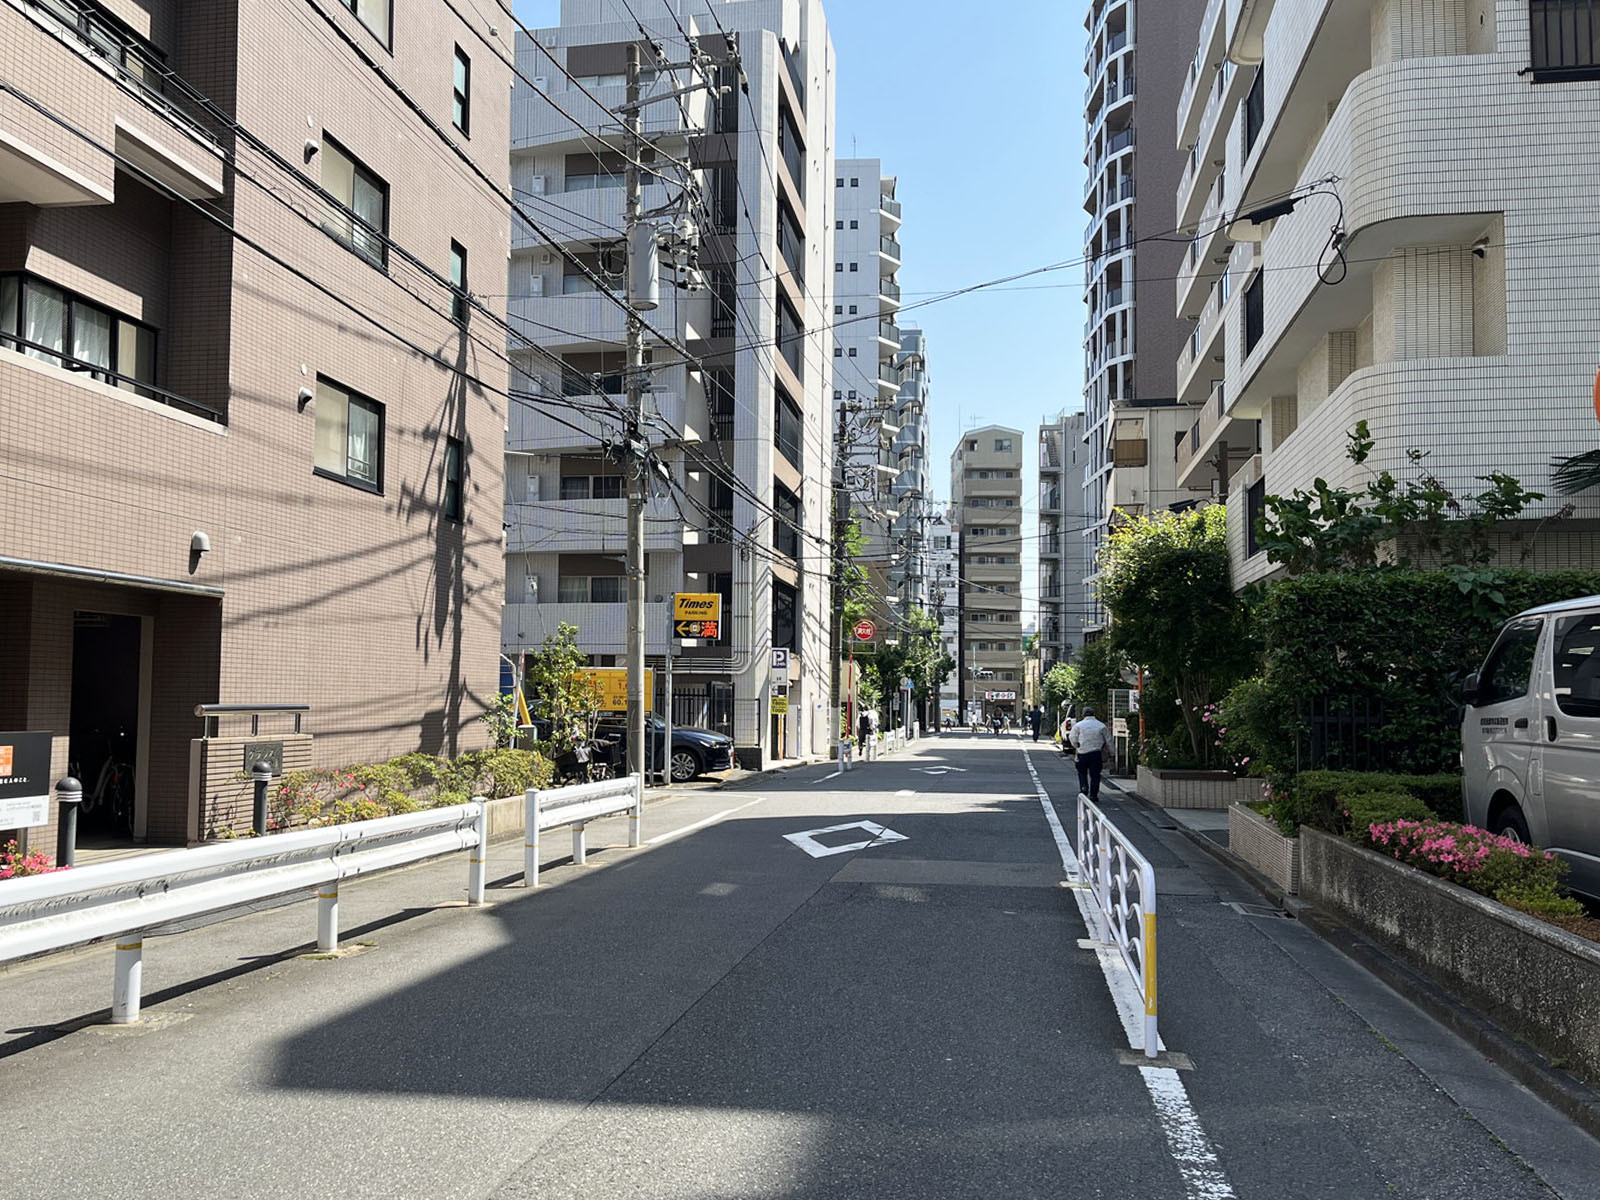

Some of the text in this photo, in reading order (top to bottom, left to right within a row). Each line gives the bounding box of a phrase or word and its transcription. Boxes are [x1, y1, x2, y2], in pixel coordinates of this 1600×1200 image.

[679, 598, 714, 609] Times
[701, 621, 717, 637] 満
[773, 651, 785, 666] P
